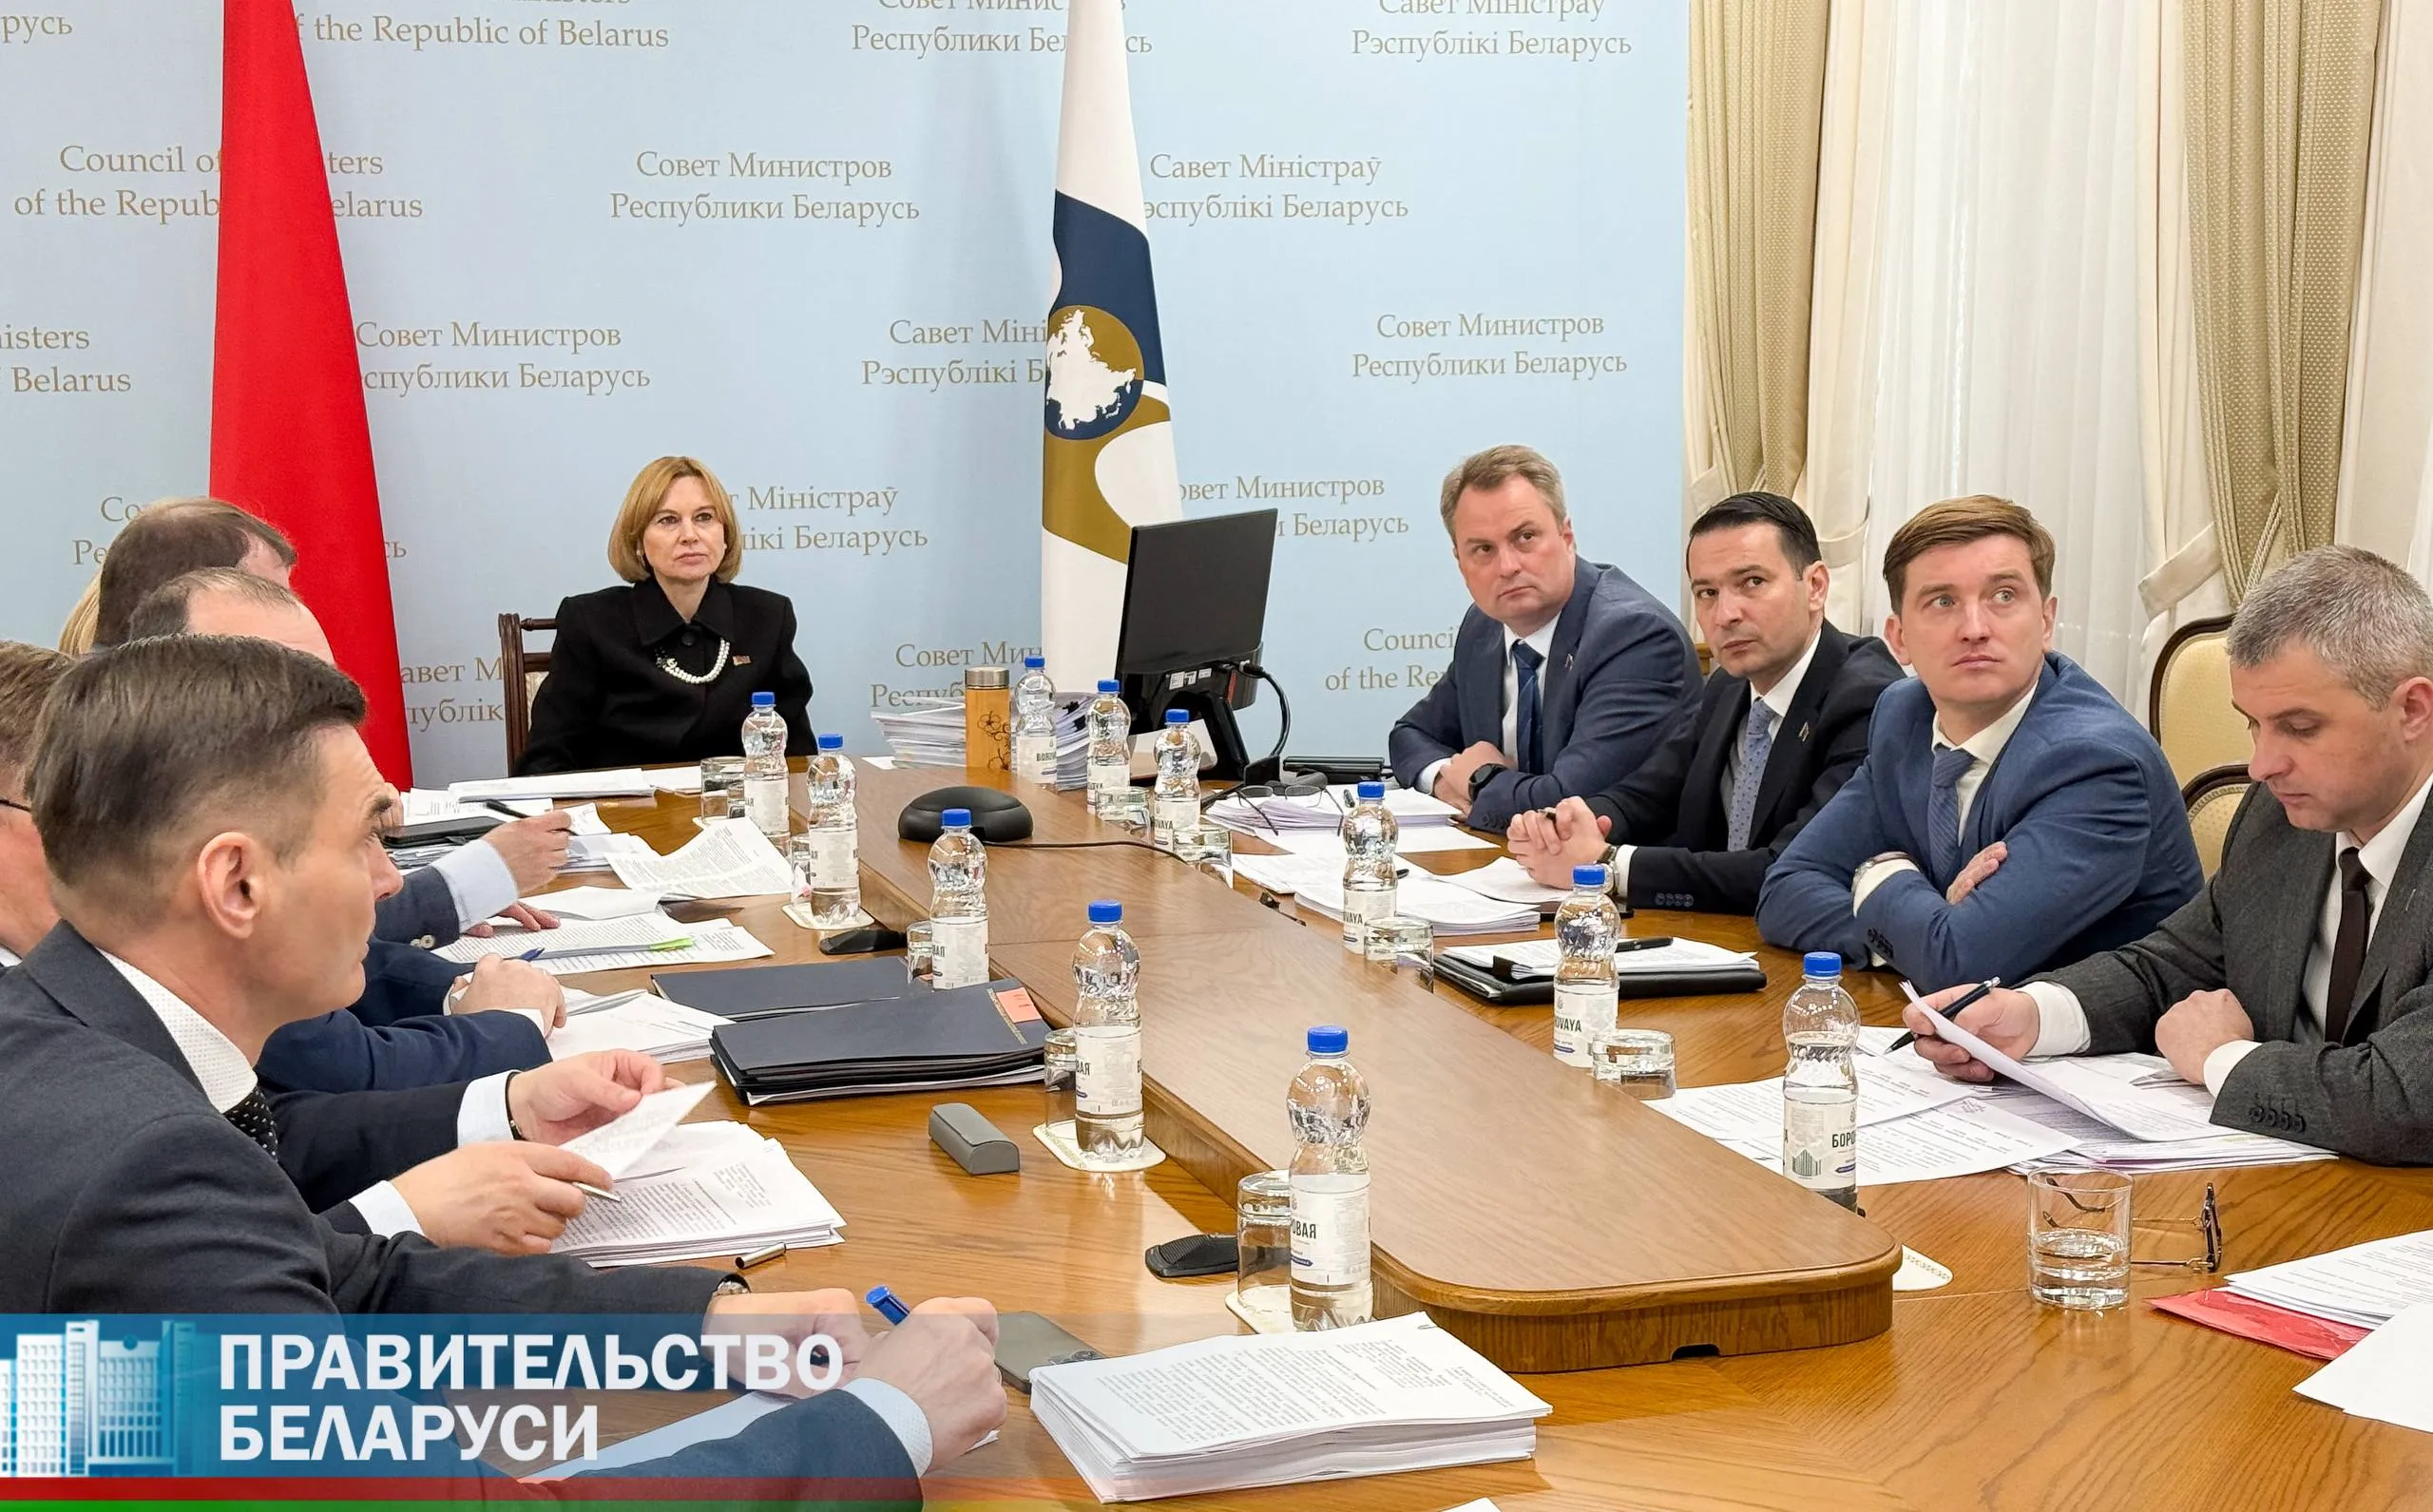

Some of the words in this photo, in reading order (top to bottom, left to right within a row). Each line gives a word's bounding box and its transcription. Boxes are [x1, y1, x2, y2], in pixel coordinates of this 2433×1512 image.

[0, 15, 73, 44] русь
[314, 14, 362, 41] the
[373, 15, 508, 51] Republic
[519, 19, 548, 45] of
[557, 20, 669, 48] Belarus
[852, 25, 1021, 60] Республики
[1351, 29, 1499, 63] Рэспублікі
[1508, 30, 1632, 63] Беларусь
[60, 145, 185, 173] Council
[637, 151, 720, 178] Совет
[728, 152, 891, 186] Министров
[1150, 153, 1232, 179] Савет
[1239, 154, 1382, 186] Міністраў
[14, 188, 46, 216] of
[55, 188, 106, 216] the
[116, 189, 219, 224] Repub
[333, 190, 423, 218] elarus
[610, 193, 783, 228] Республики
[793, 193, 920, 228] Беларусь
[1144, 194, 1274, 227] эспублікі
[1282, 194, 1408, 226] Беларусь
[5, 324, 90, 350] isters
[355, 321, 443, 348] Совет
[450, 321, 622, 354] Министров
[890, 319, 974, 345] Савет
[1377, 315, 1451, 338] Совет
[1459, 312, 1604, 345] Министров
[11, 366, 132, 392] Belarus
[364, 363, 509, 397] спублики
[519, 363, 651, 396] Беларусь
[861, 358, 1018, 393] Рэспублікі
[1352, 352, 1506, 382] Республики
[1514, 351, 1628, 382] Беларусь
[747, 486, 899, 517] Міністраў
[1178, 484, 1229, 501] вет
[1236, 475, 1386, 506] Министров
[794, 526, 929, 556] Беларусь
[1293, 513, 1409, 543] Беларусь
[895, 643, 974, 667] Совет
[1364, 627, 1455, 652] Counci
[401, 664, 466, 684] авет
[1326, 667, 1351, 691] of
[1358, 666, 1399, 690] the
[1555, 1016, 1582, 1032] OVAYA
[1831, 1130, 1856, 1148] БОРО
[1291, 1218, 1316, 1239] ОВАЯ
